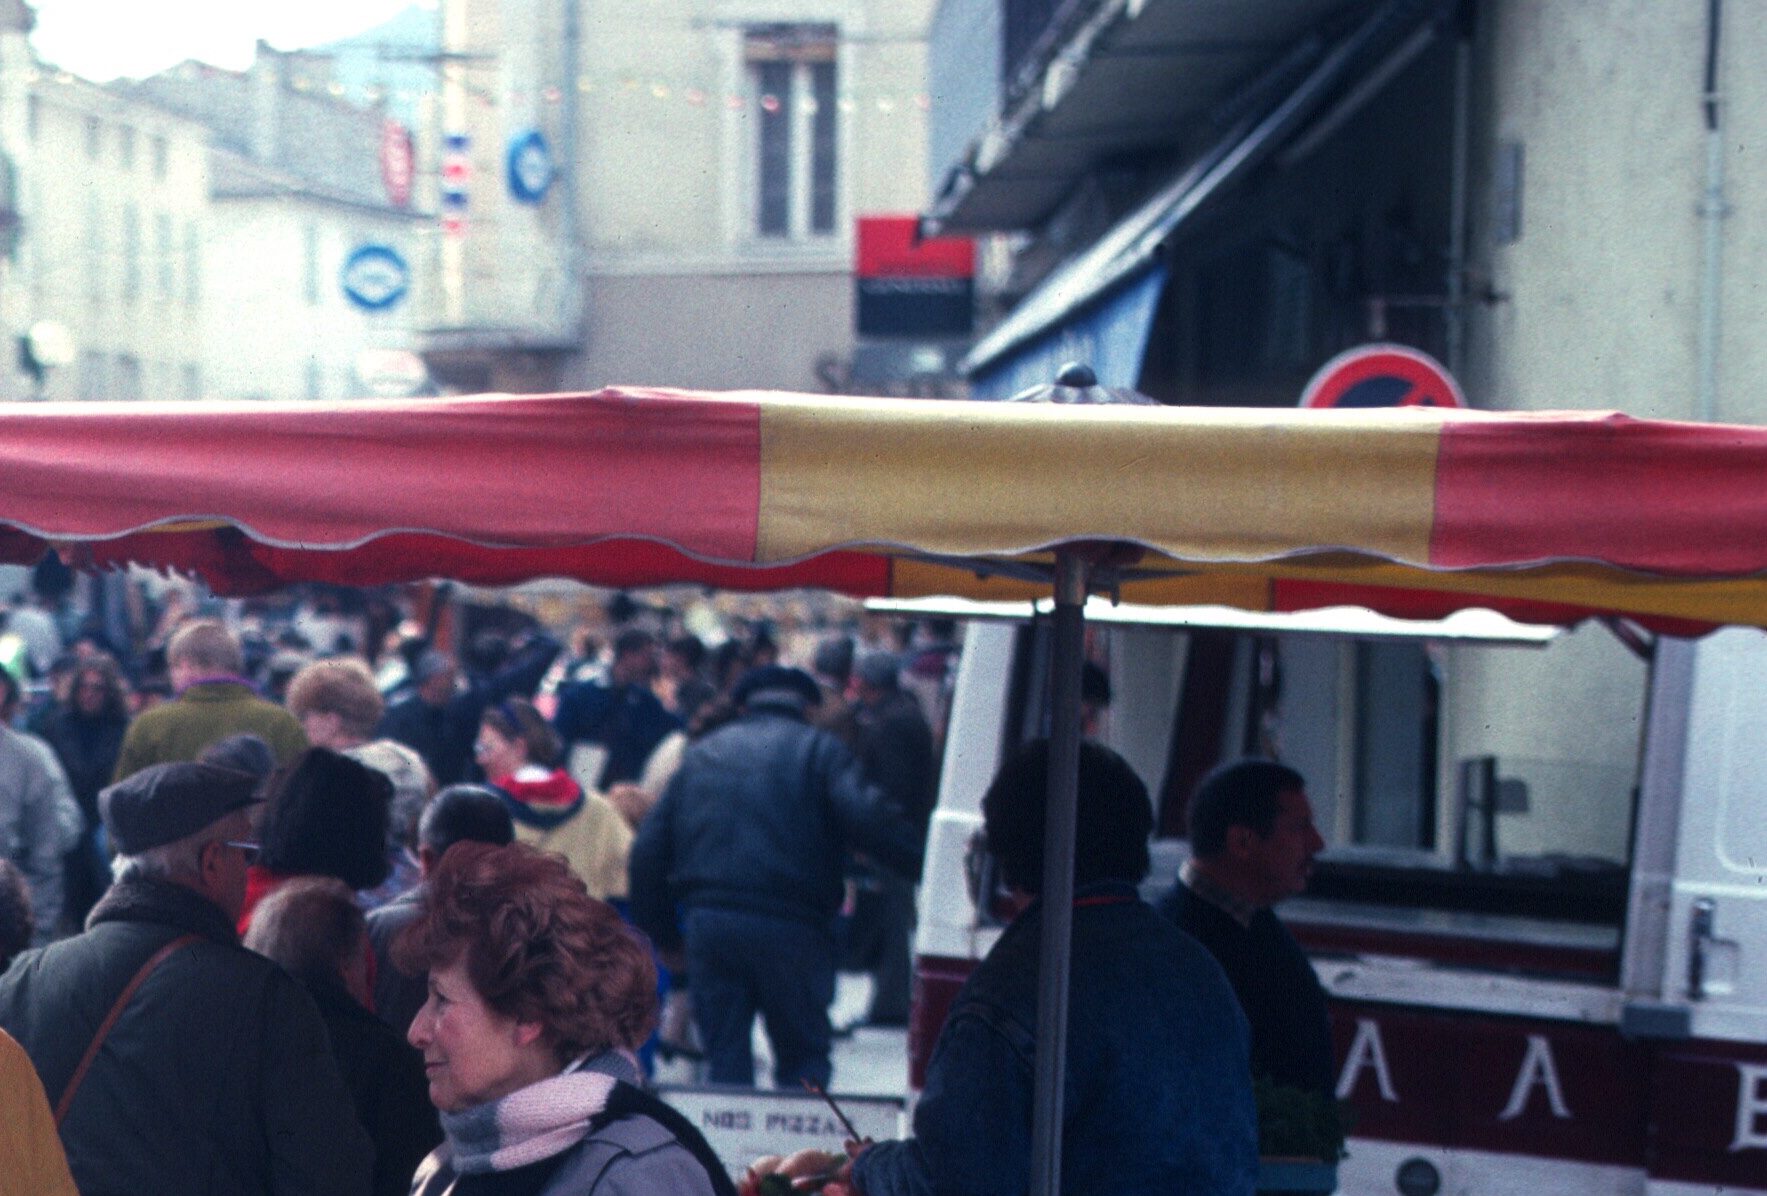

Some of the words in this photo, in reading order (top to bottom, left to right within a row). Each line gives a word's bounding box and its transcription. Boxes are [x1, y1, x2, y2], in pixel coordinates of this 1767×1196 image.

[1334, 1019, 1400, 1101] A
[1497, 1034, 1573, 1122] A
[702, 1110, 750, 1131] NOS
